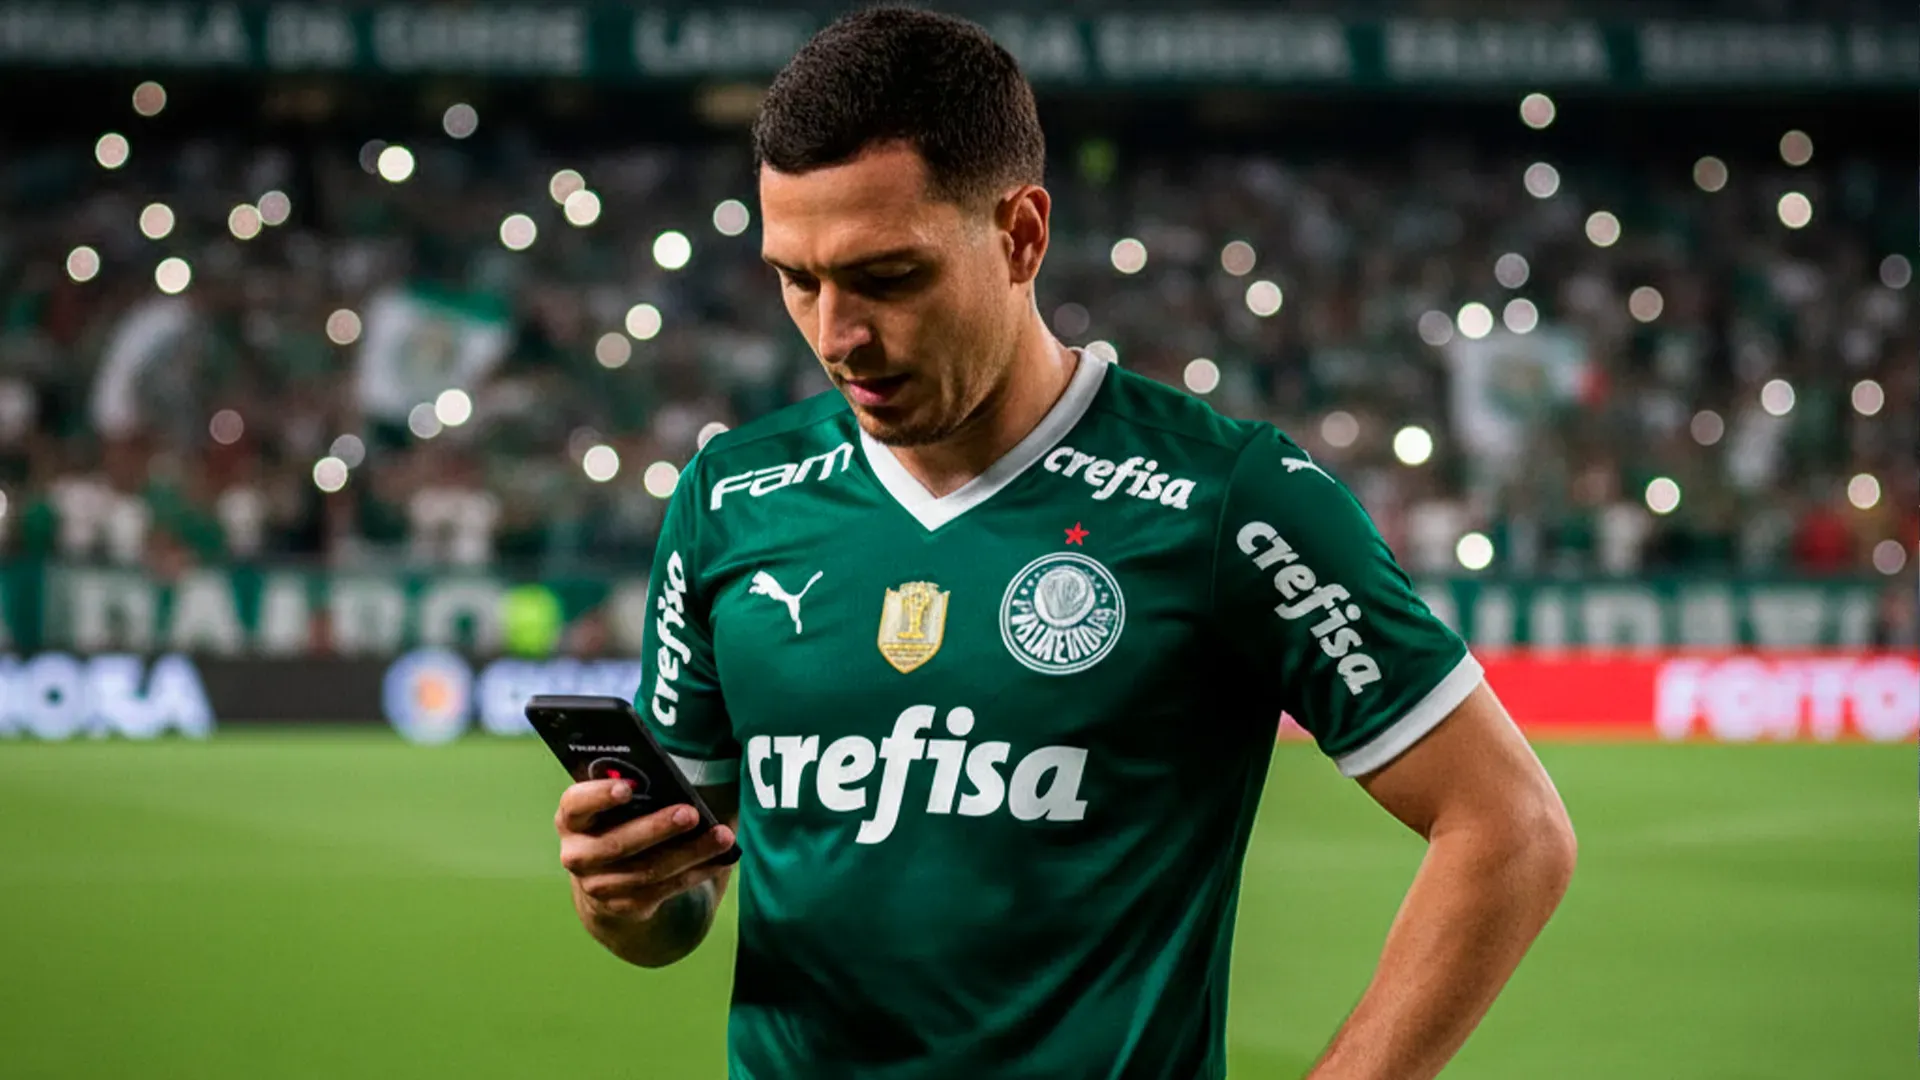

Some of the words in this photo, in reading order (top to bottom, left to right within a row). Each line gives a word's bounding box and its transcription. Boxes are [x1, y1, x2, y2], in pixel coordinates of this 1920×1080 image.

[1043, 446, 1196, 510] crefisa
[651, 550, 692, 726] crefisa
[1236, 520, 1382, 695] crefisa
[747, 704, 1088, 844] crefisa
